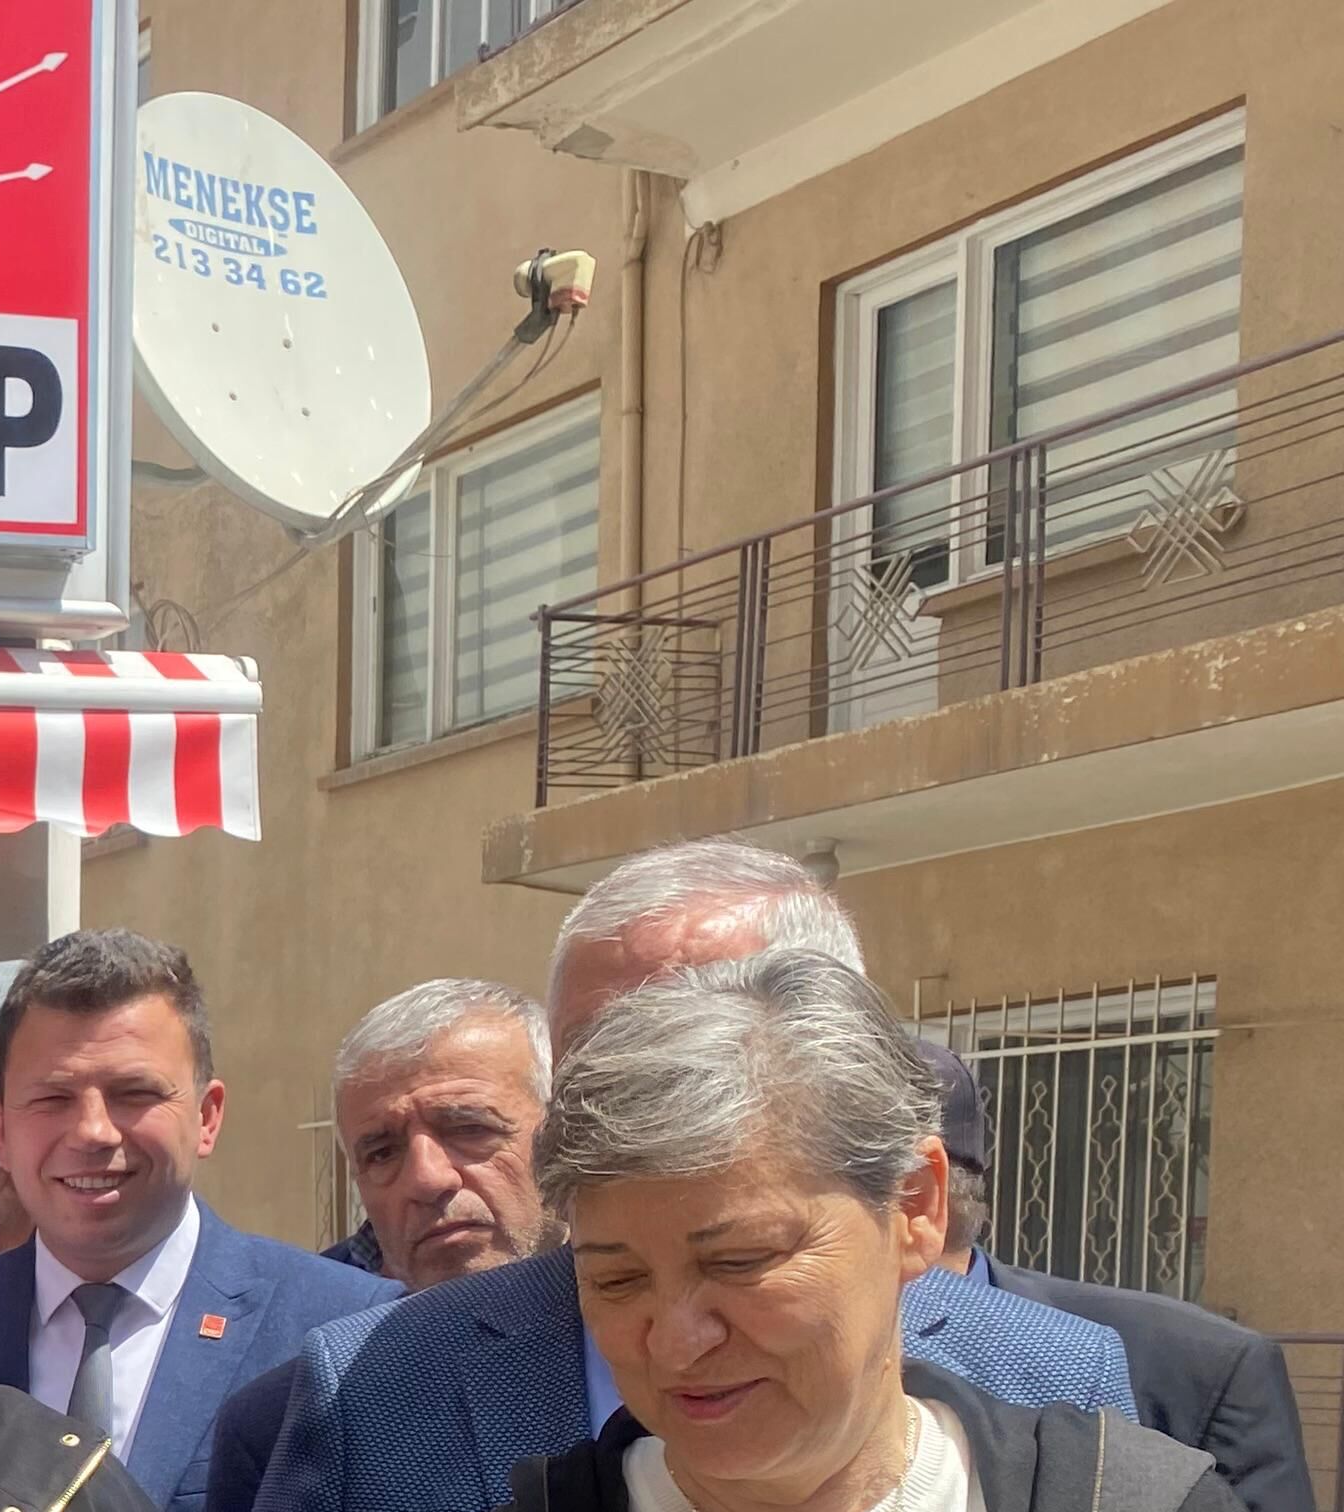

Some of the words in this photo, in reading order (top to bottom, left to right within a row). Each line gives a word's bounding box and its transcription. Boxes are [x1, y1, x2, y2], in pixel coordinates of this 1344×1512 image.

[183, 220, 266, 256] DIGITAL
[152, 233, 212, 278] 213
[223, 257, 267, 291] 34
[279, 268, 328, 299] 62
